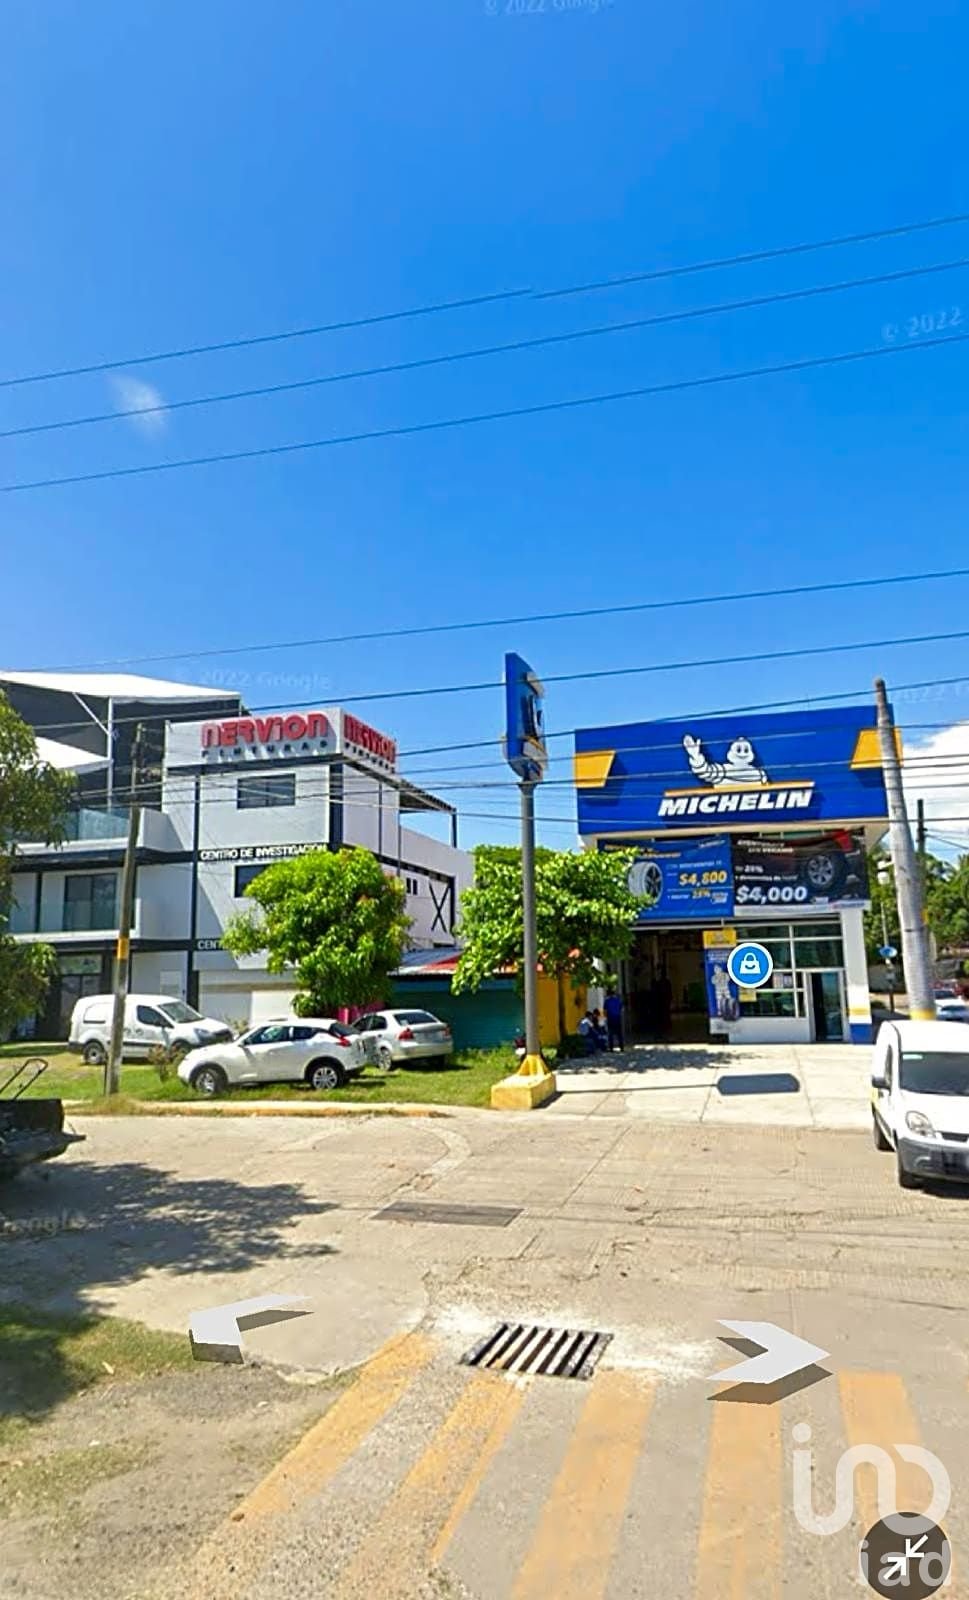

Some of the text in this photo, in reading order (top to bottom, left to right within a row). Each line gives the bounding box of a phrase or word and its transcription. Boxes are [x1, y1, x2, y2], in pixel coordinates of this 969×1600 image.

[658, 789, 813, 817] MICHELIN
[200, 848, 239, 861] CENTRO
[240, 847, 254, 858] DE
[735, 885, 808, 904] $4,000
